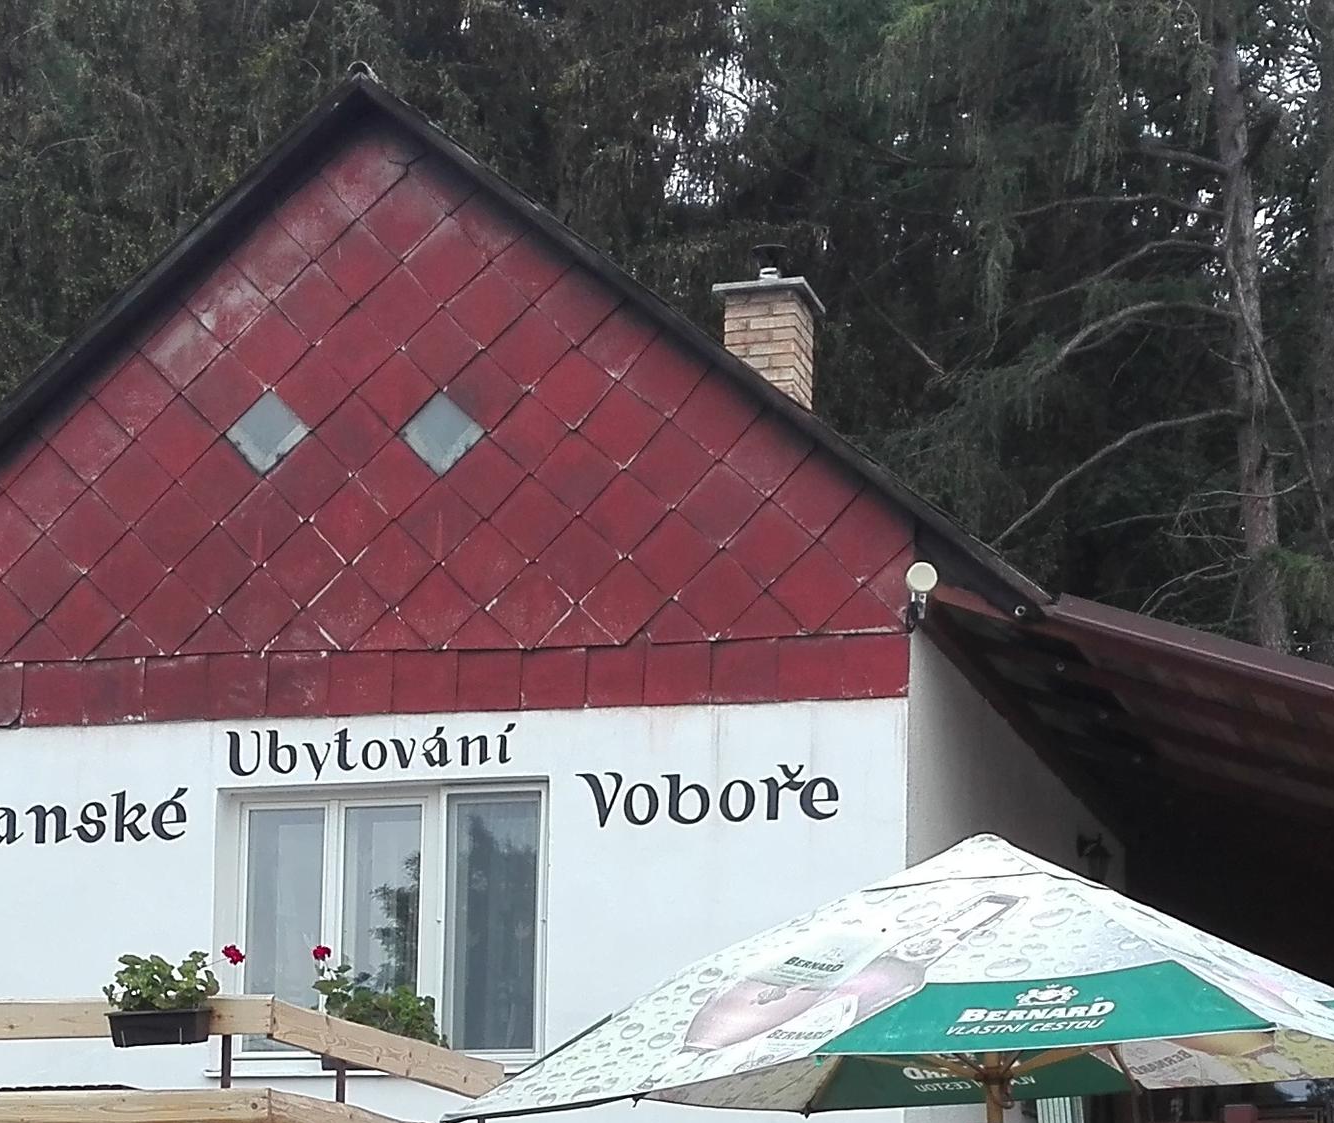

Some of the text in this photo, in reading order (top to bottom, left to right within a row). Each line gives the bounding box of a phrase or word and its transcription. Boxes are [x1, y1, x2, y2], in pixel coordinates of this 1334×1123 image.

[226, 722, 516, 781] Ubytování
[575, 763, 839, 828] Voboře
[784, 956, 844, 973] BERNARD
[956, 997, 1115, 1023] BERNARD
[946, 1019, 1105, 1036] VLASTNÍ CESTOU
